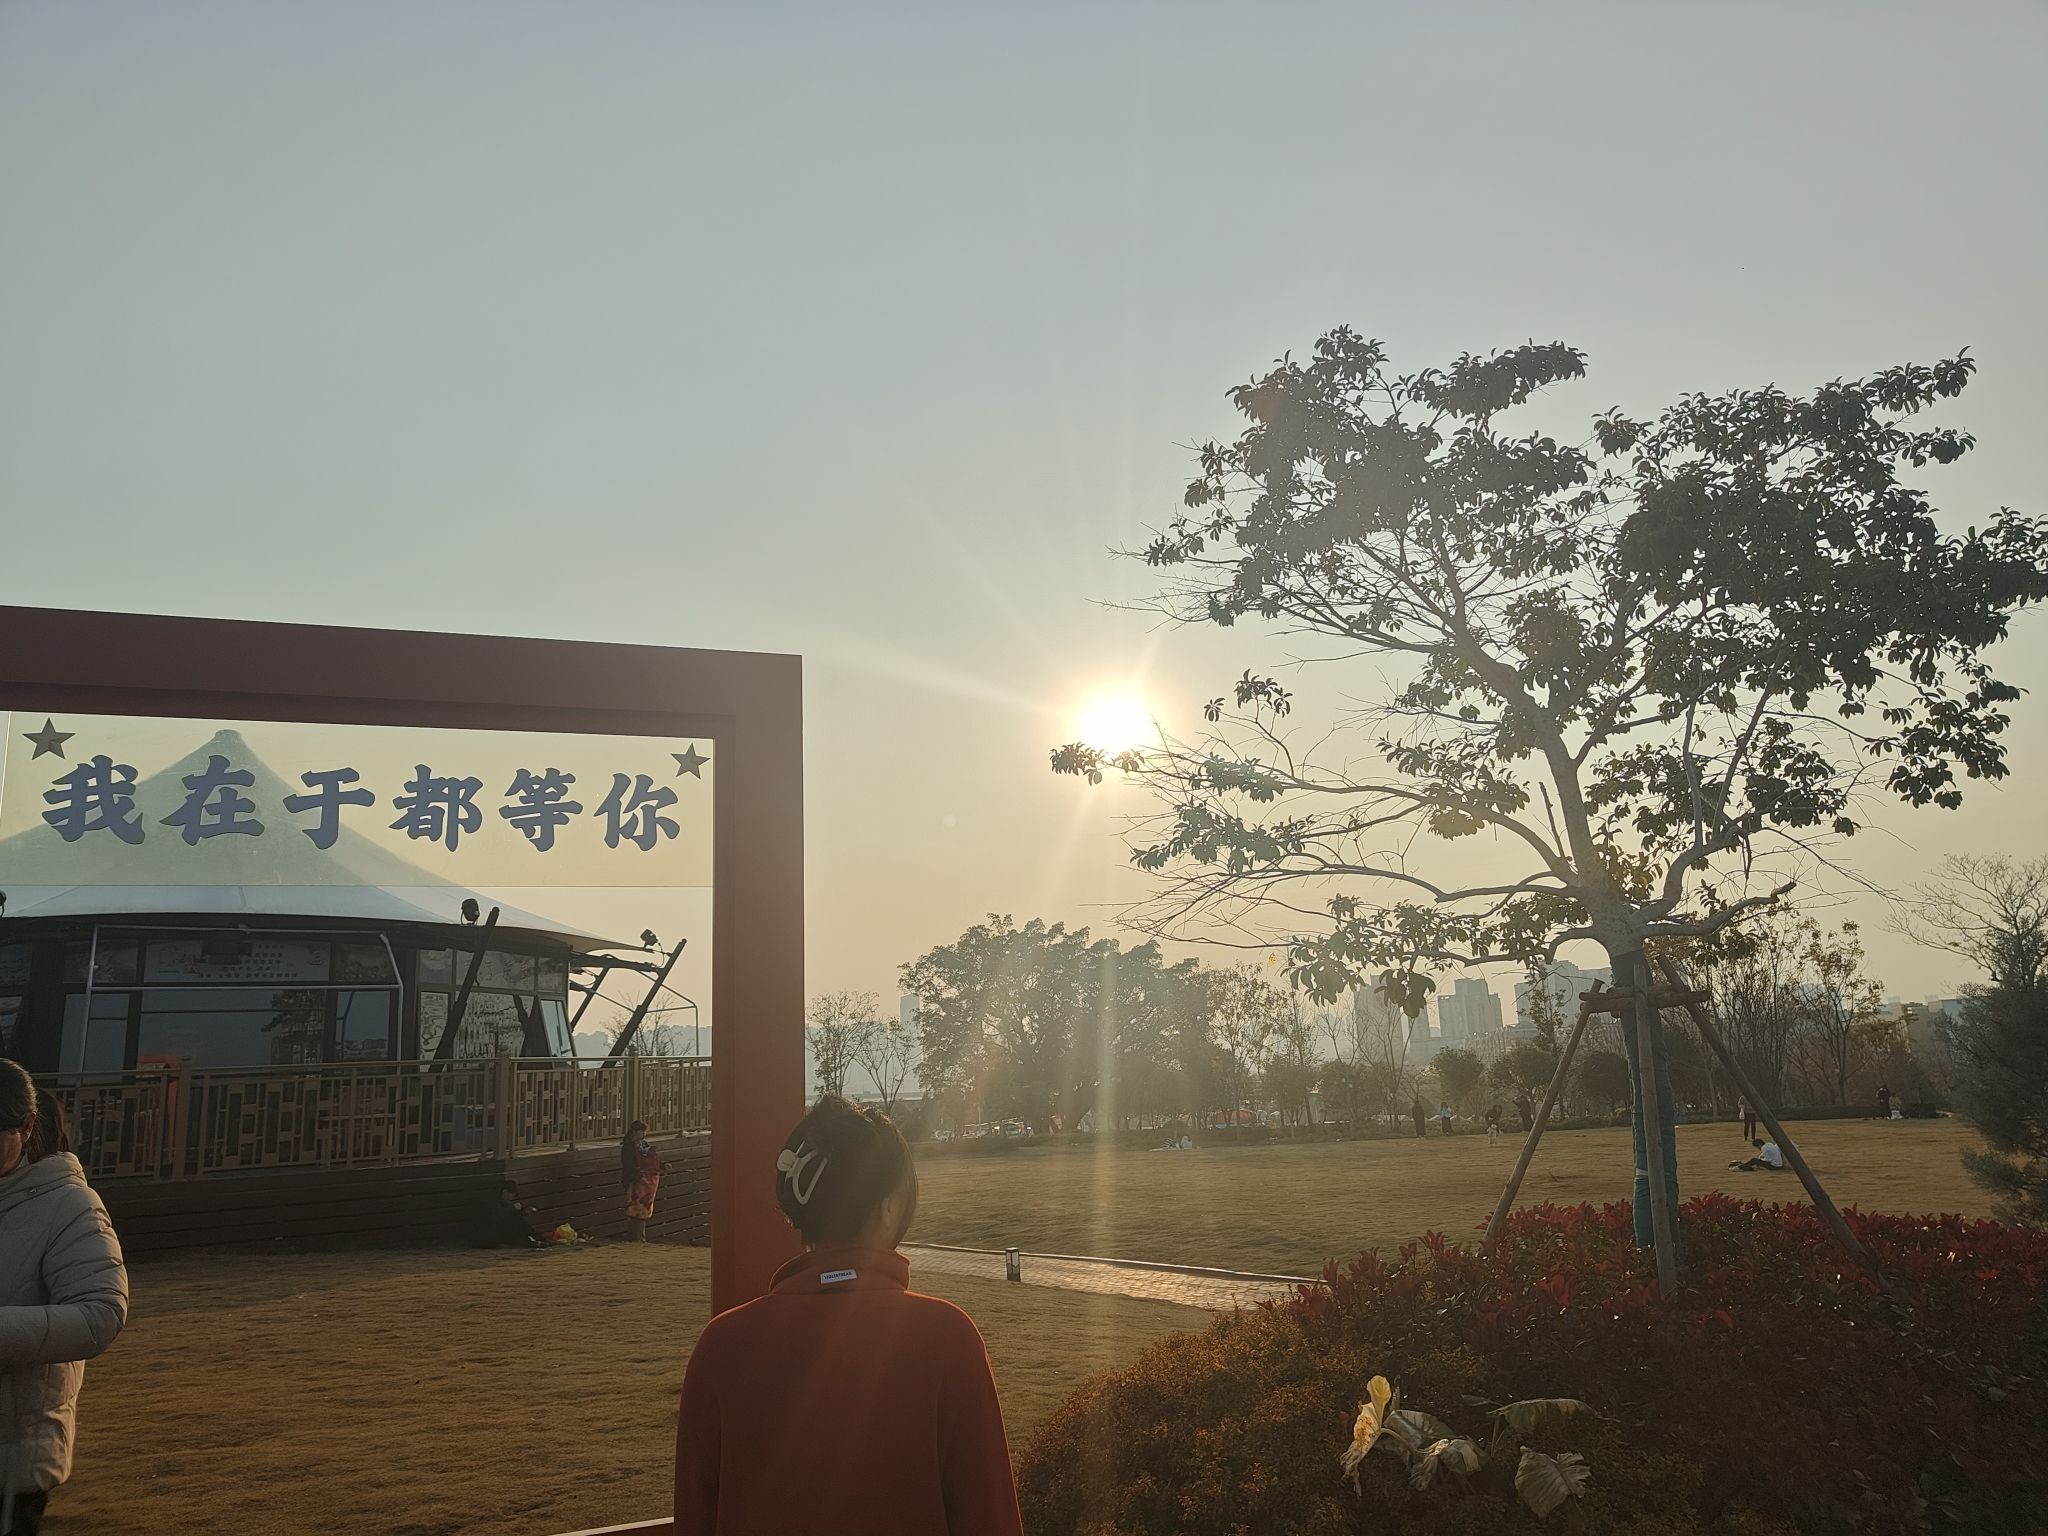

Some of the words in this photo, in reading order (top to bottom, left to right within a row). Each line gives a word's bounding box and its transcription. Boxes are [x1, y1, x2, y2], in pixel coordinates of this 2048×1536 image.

[42, 755, 680, 852] 我在于都等你
